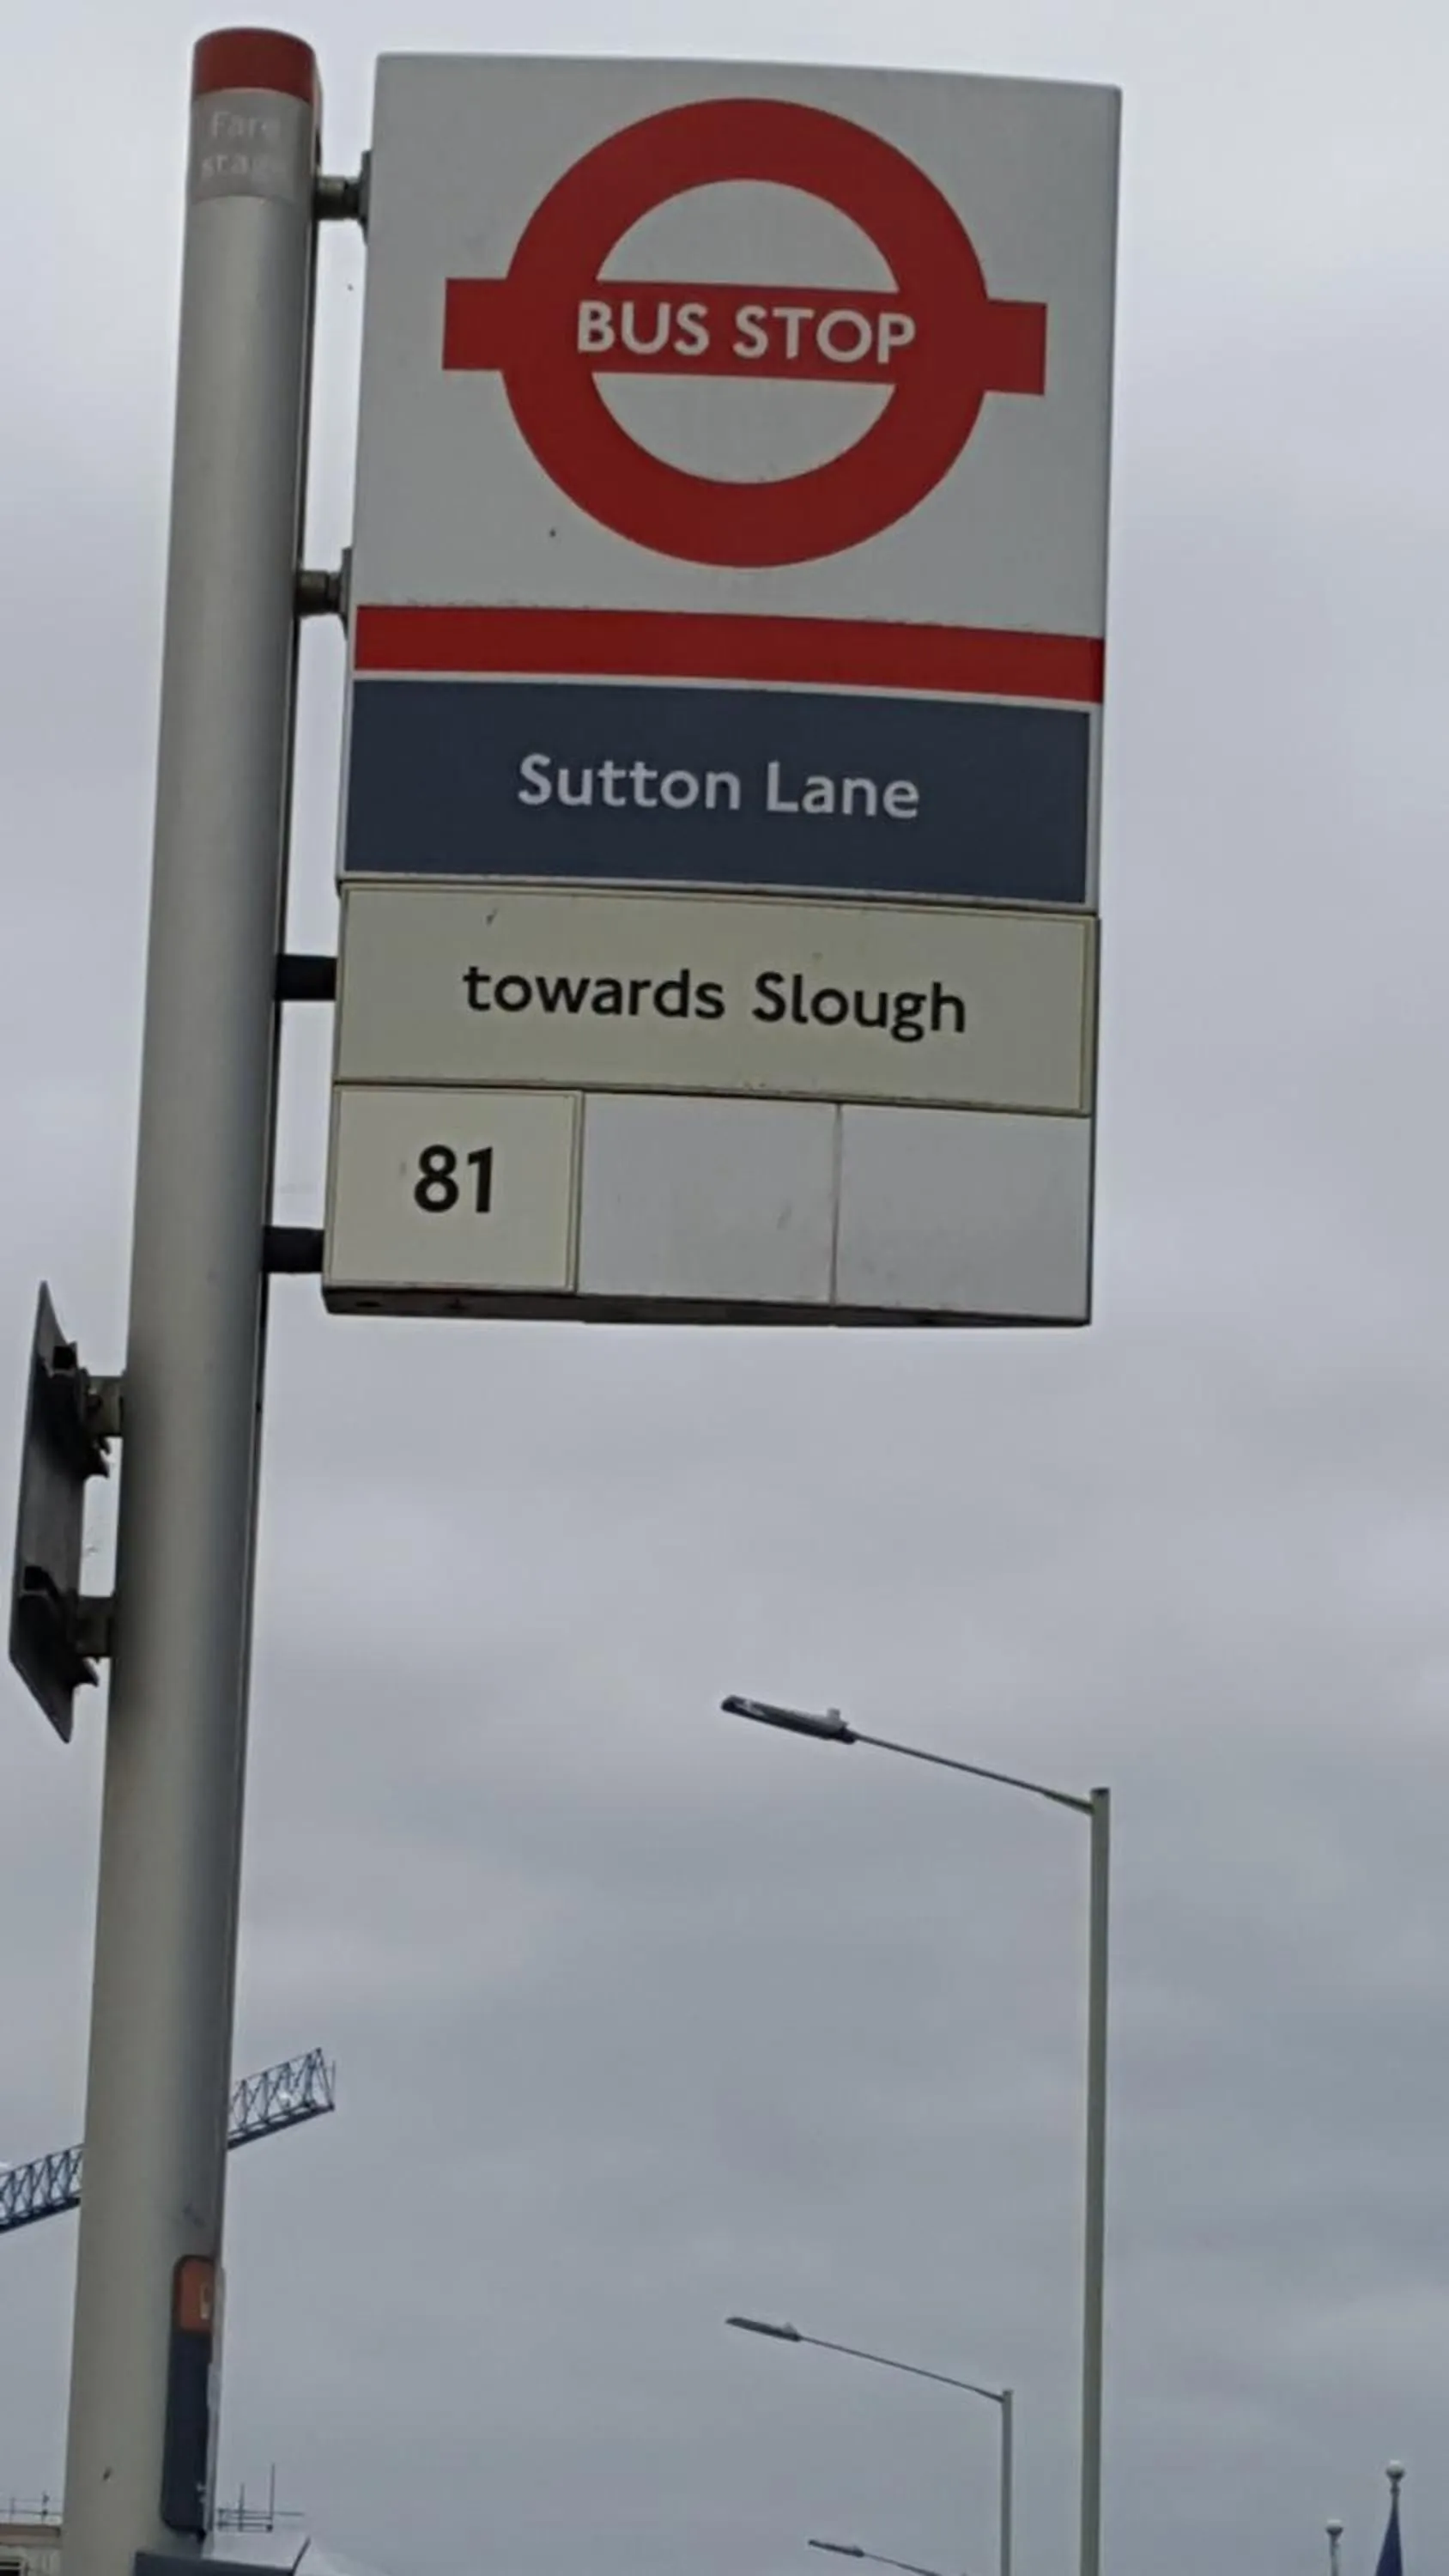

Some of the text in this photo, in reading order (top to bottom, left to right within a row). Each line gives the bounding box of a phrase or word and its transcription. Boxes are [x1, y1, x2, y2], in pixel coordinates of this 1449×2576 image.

[577, 301, 916, 364] BUS STOP
[518, 753, 919, 818] Sutton Lane
[462, 966, 966, 1043] towards Slough
[414, 1144, 493, 1213] 81
